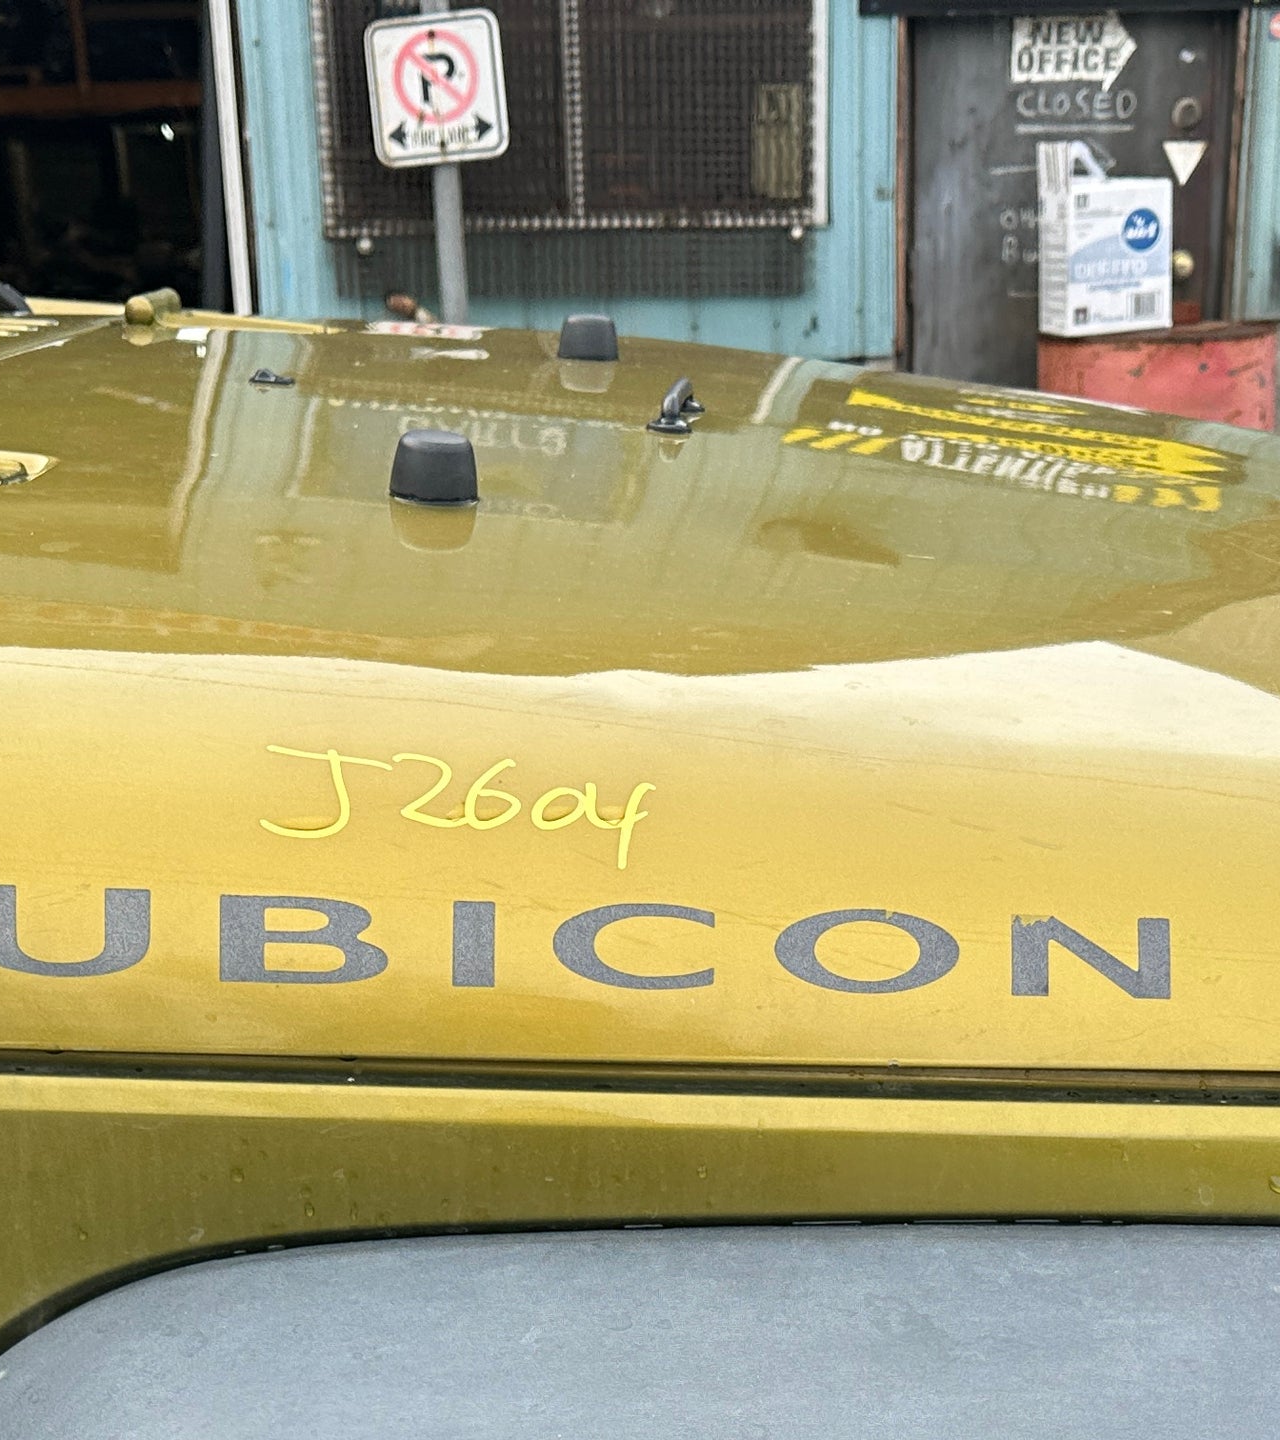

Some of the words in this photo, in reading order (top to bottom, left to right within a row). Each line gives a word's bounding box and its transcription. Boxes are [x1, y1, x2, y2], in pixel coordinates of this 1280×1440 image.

[1031, 20, 1105, 44] NEW
[1017, 47, 1120, 73] OFFICE
[1016, 87, 1138, 119] CLOSED
